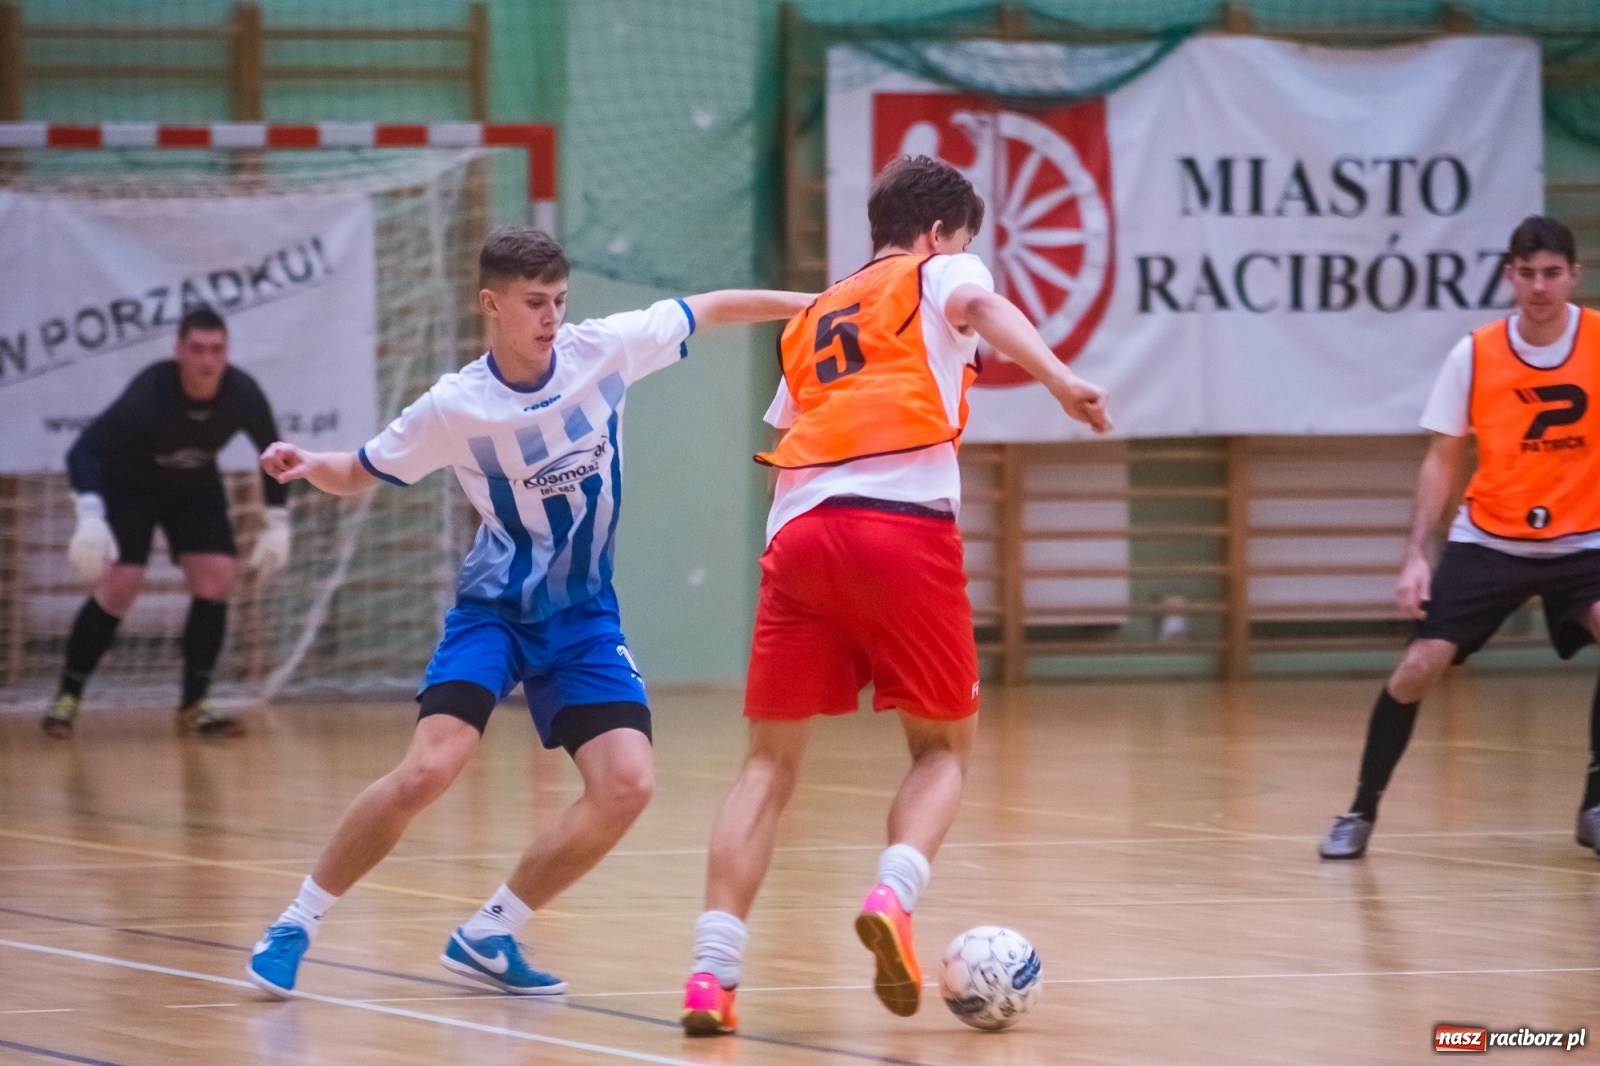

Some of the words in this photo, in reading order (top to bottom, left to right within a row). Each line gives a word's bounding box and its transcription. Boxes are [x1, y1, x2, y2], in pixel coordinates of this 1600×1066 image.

[1179, 153, 1471, 218] MIASTO
[1136, 233, 1518, 315] RACIBÓRZ
[814, 302, 866, 384] 5
